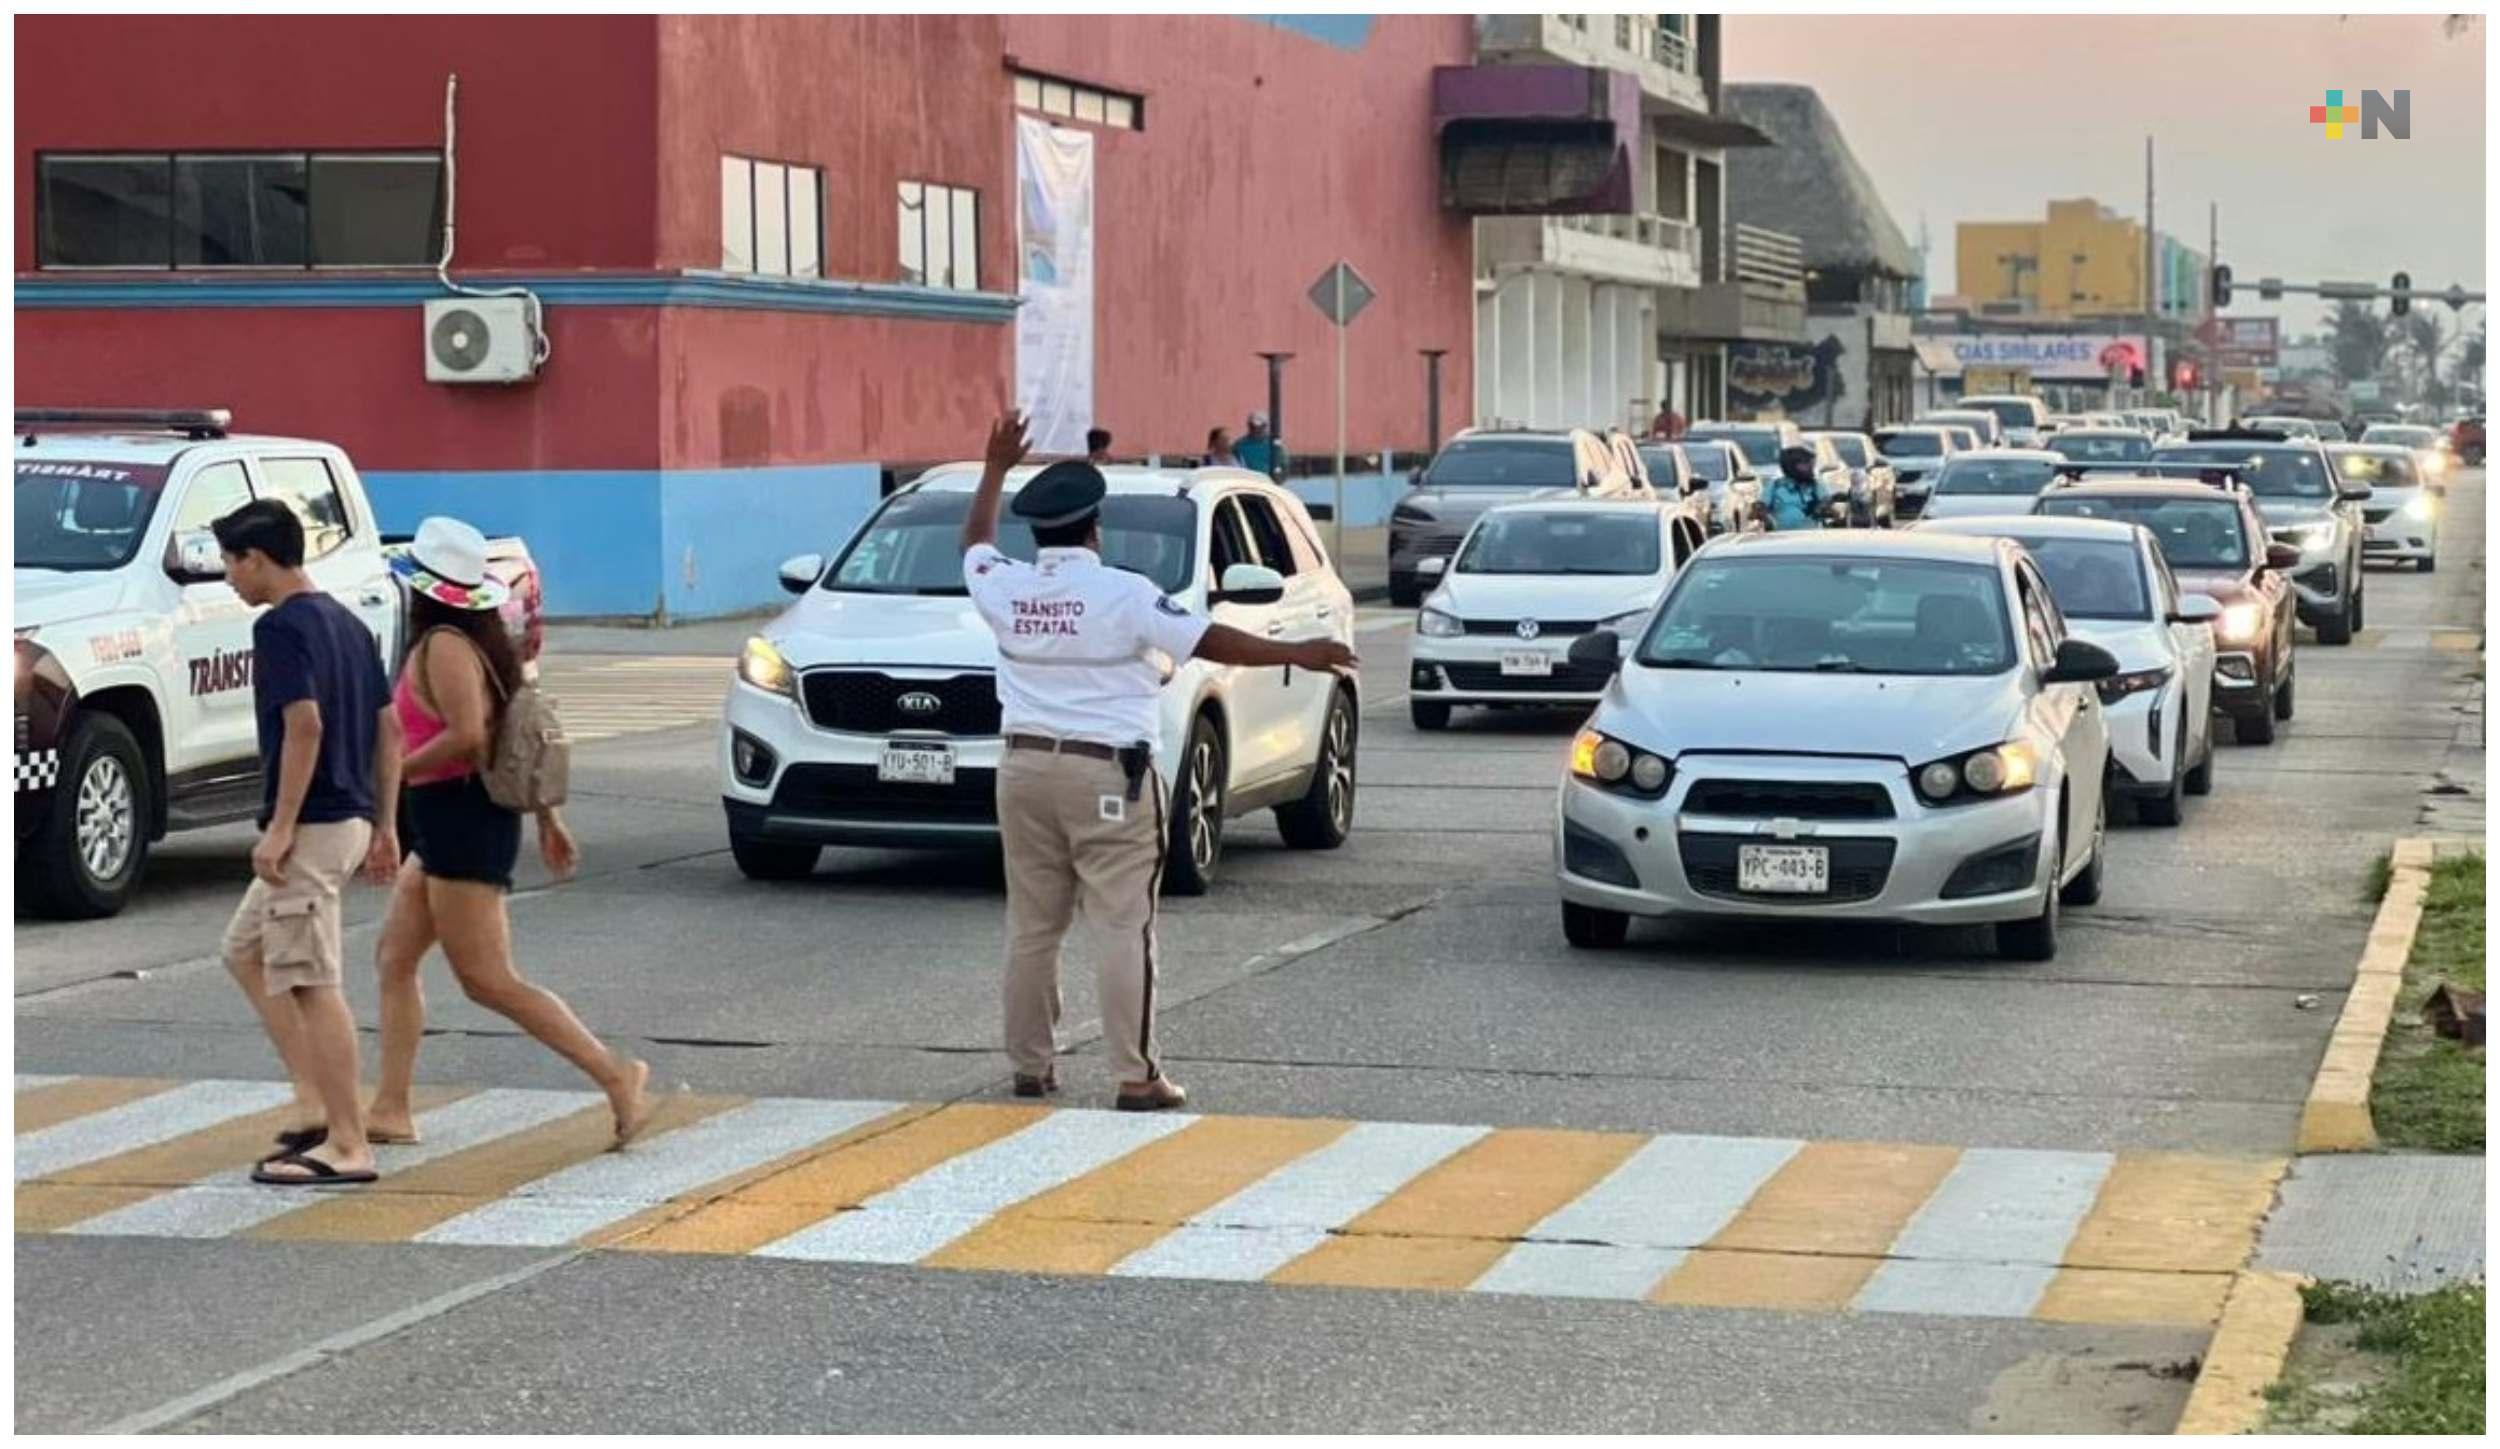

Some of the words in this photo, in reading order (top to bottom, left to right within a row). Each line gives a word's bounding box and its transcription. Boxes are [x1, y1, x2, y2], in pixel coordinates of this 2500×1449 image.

[1999, 342, 2091, 361] SIMILARES
[1012, 597, 1085, 617] TRÁNSITO
[1014, 619, 1079, 635] ESTATAL
[900, 694, 938, 710] KIA
